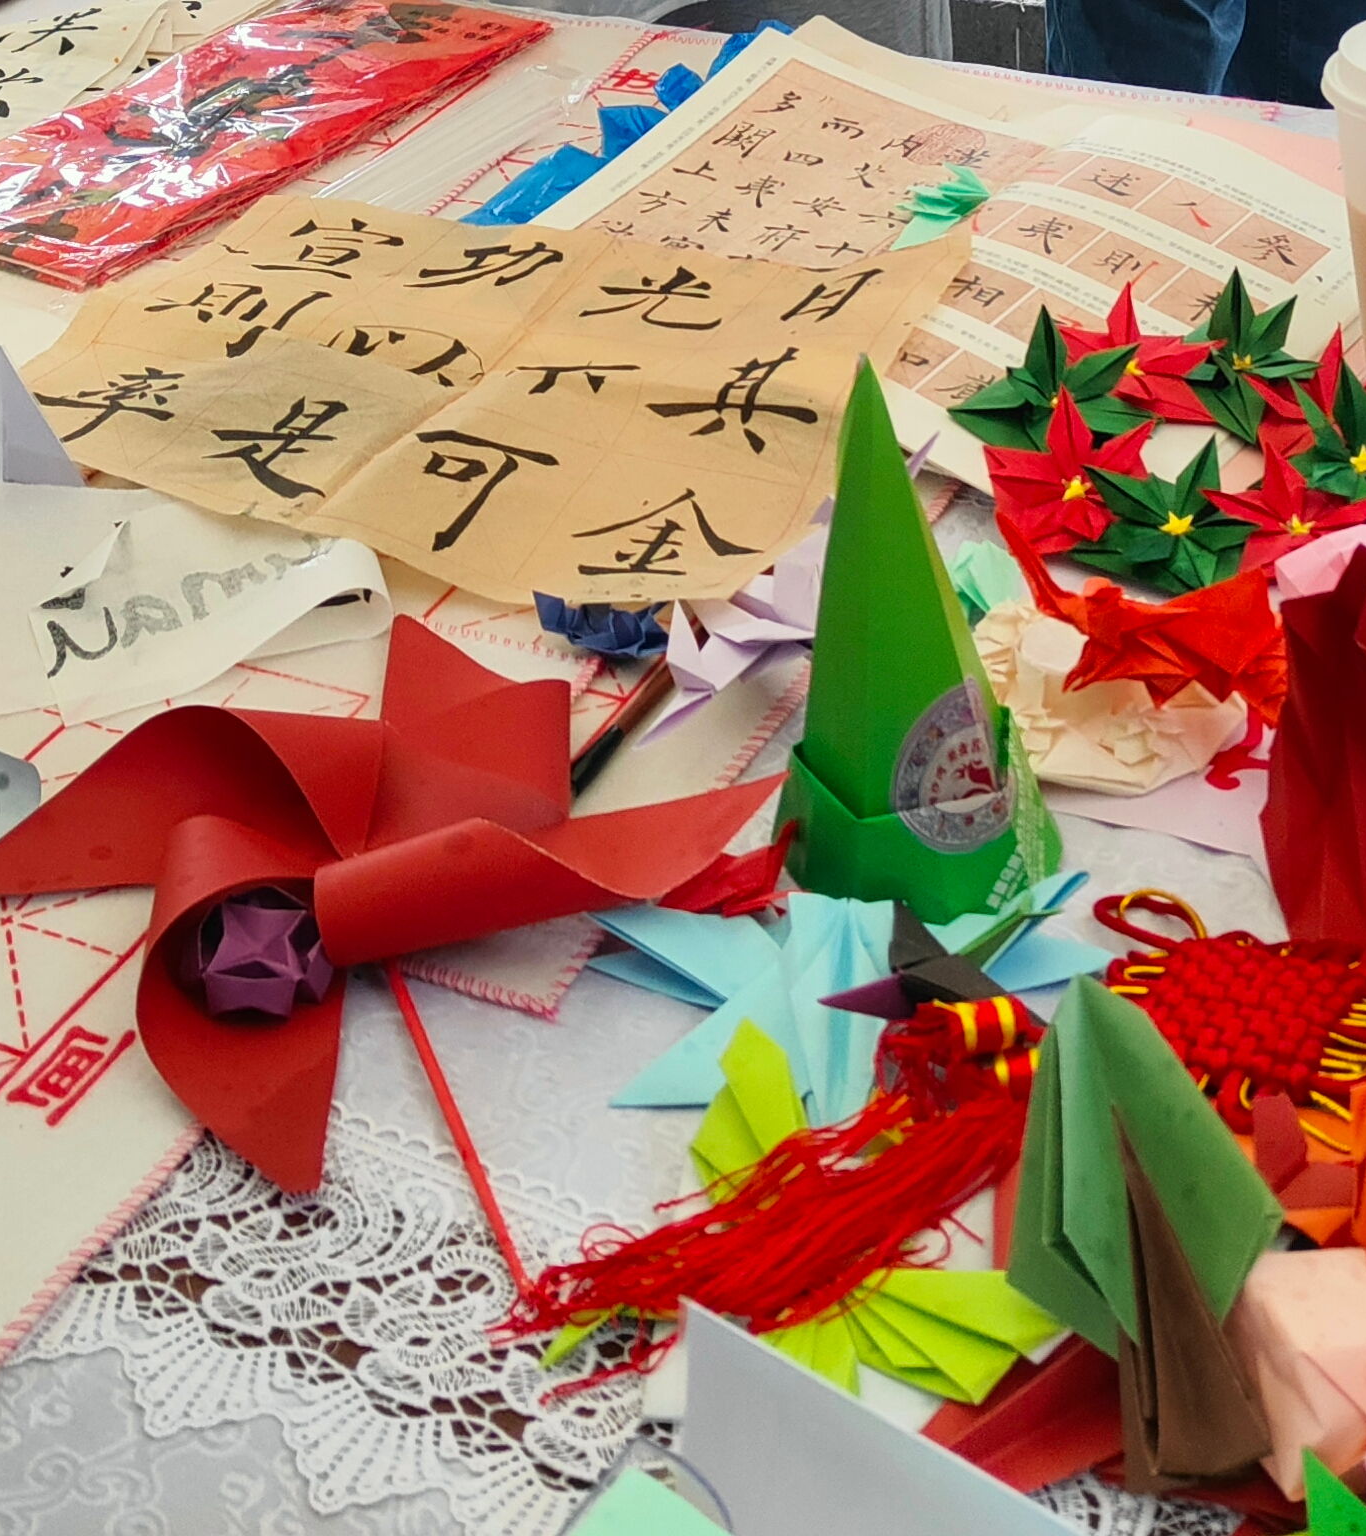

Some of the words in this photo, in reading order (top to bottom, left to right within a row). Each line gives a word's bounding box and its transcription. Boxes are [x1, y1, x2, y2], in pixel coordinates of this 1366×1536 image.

[251, 217, 405, 280] 宣
[403, 242, 564, 288] 功
[951, 274, 1005, 309] 相
[578, 265, 723, 330] 光
[645, 346, 819, 455] 其
[201, 395, 349, 499] 是
[415, 429, 561, 552] 可
[571, 487, 765, 576] 金
[6, 1025, 138, 1128] 画
